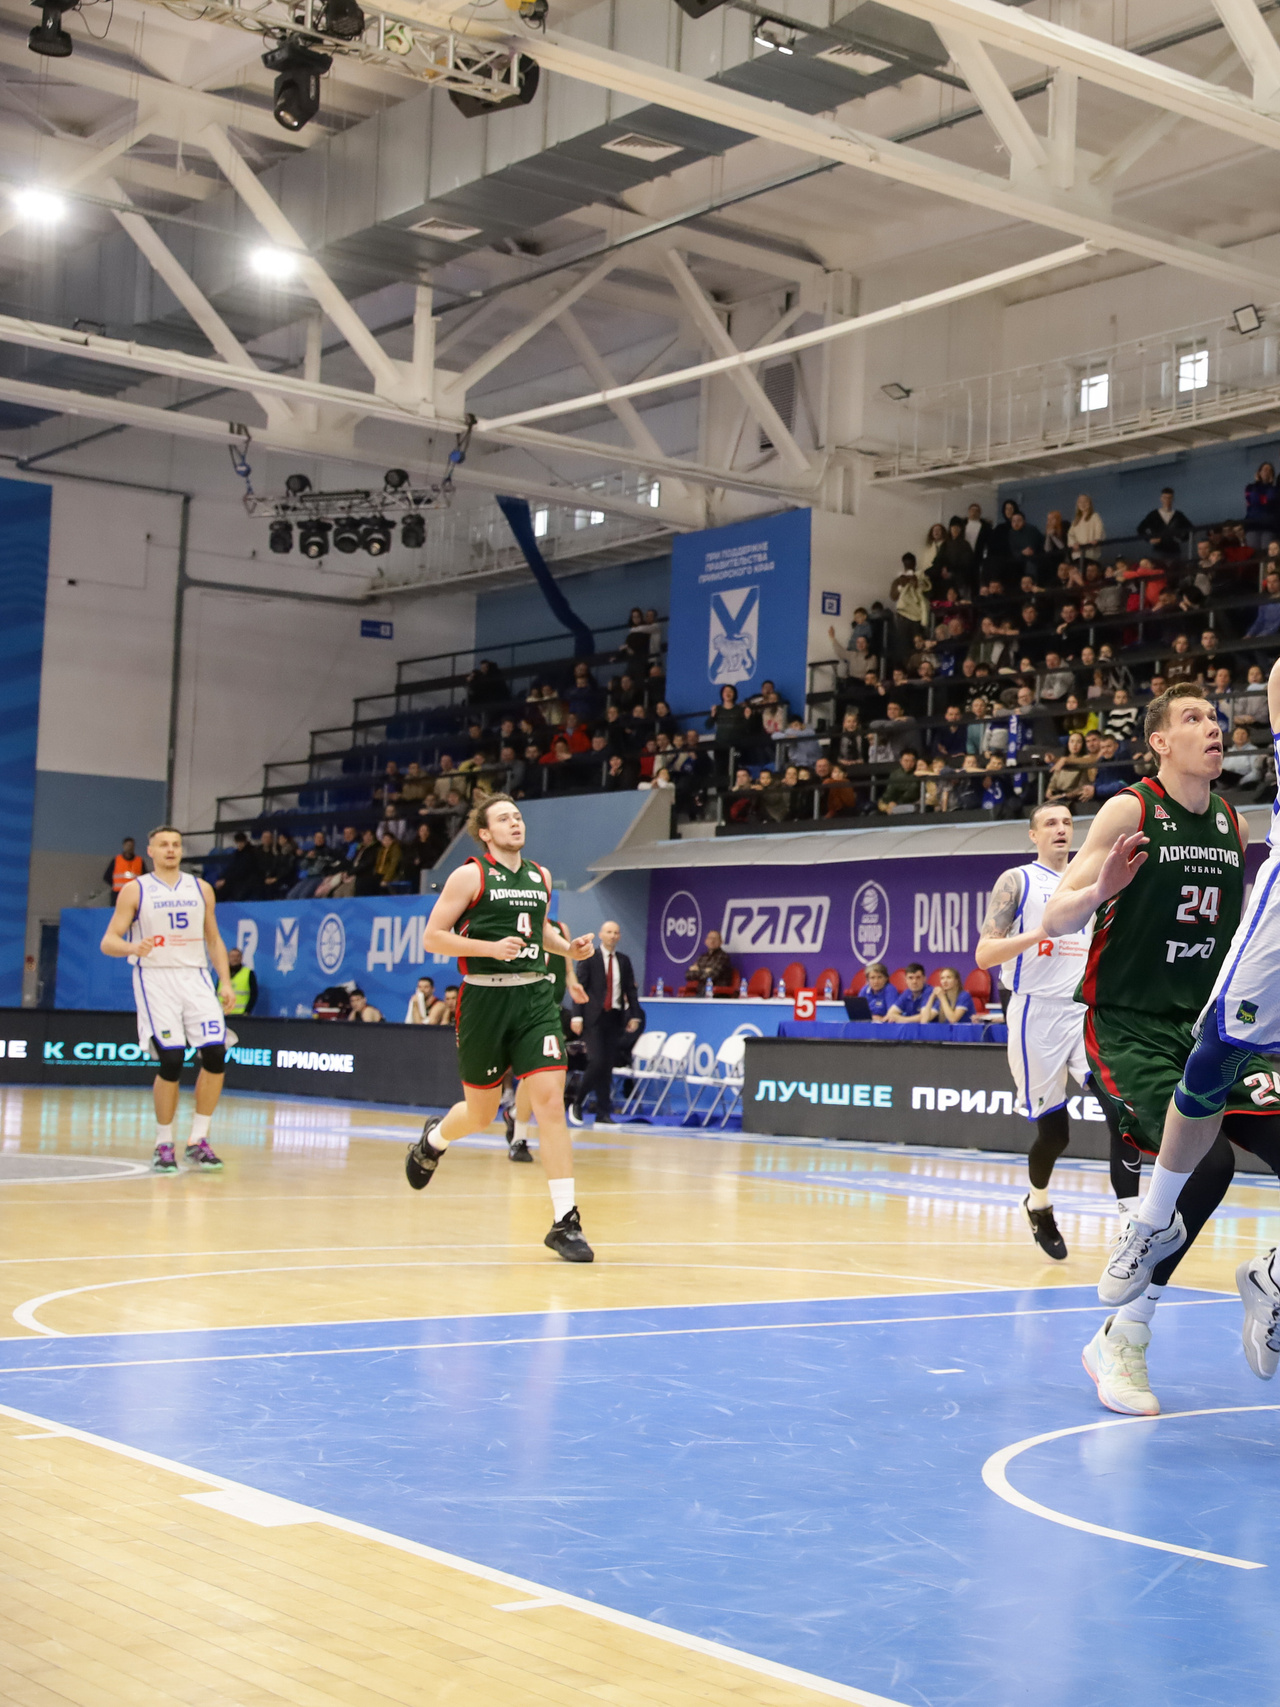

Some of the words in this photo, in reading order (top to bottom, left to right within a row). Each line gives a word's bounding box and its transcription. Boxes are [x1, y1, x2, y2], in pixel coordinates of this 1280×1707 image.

[1159, 846, 1239, 868] ЛОКОМОТИВ
[1184, 865, 1222, 875] КУБАНЬ
[1176, 885, 1221, 924] 24
[168, 912, 189, 929] 15
[517, 912, 533, 938] 4
[666, 917, 697, 937] РФБ
[724, 904, 824, 945] PARI
[914, 892, 970, 953] PARI
[796, 991, 814, 1018] 5
[201, 1020, 221, 1036] 15
[44, 1041, 65, 1059] К
[543, 1035, 561, 1059] 4
[277, 1050, 354, 1073] ПРИЛОЖЕ
[755, 1079, 893, 1108] ЛУЧШЕЕ
